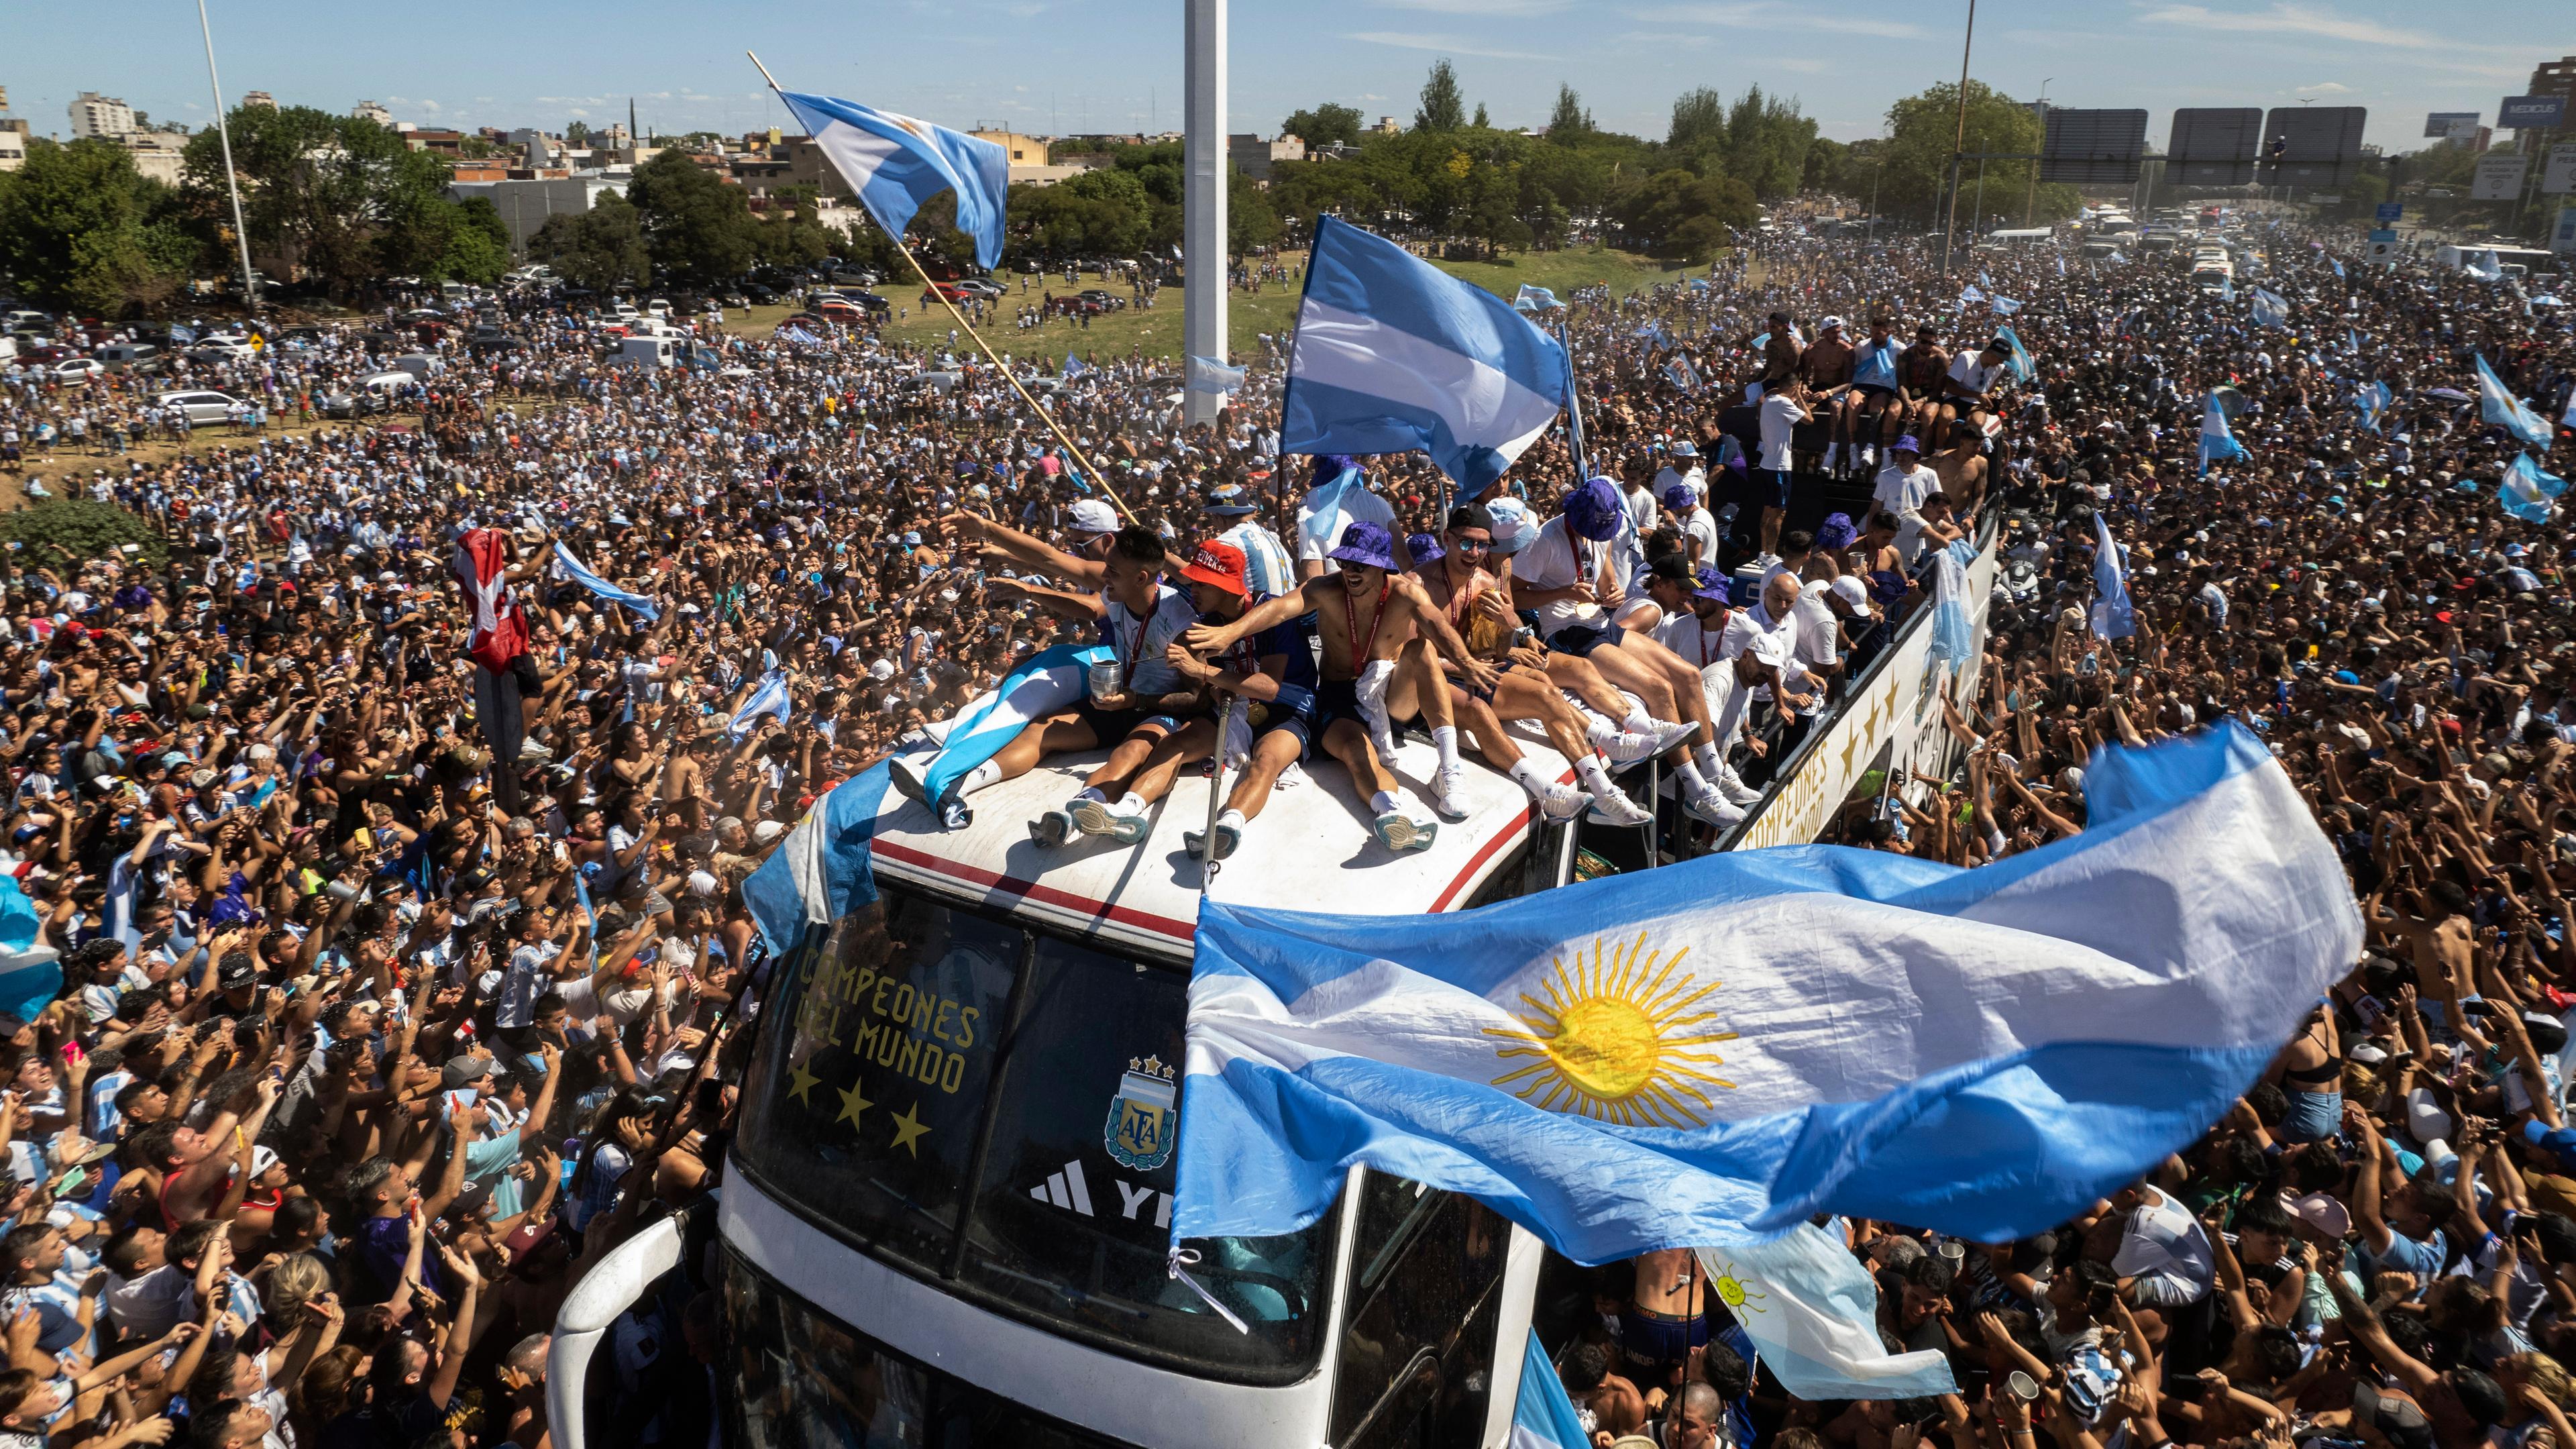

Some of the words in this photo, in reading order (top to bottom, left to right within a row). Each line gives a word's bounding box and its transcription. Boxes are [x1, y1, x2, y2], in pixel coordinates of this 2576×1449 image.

[2510, 104, 2557, 113] MEDICUS
[1196, 549, 1220, 570] RIVER
[1913, 710, 1936, 763] YPF
[800, 947, 980, 1049] CAMPEONES
[794, 991, 842, 1046] DEL
[853, 1016, 966, 1095] MUNDO
[1119, 1104, 1156, 1149] AFA
